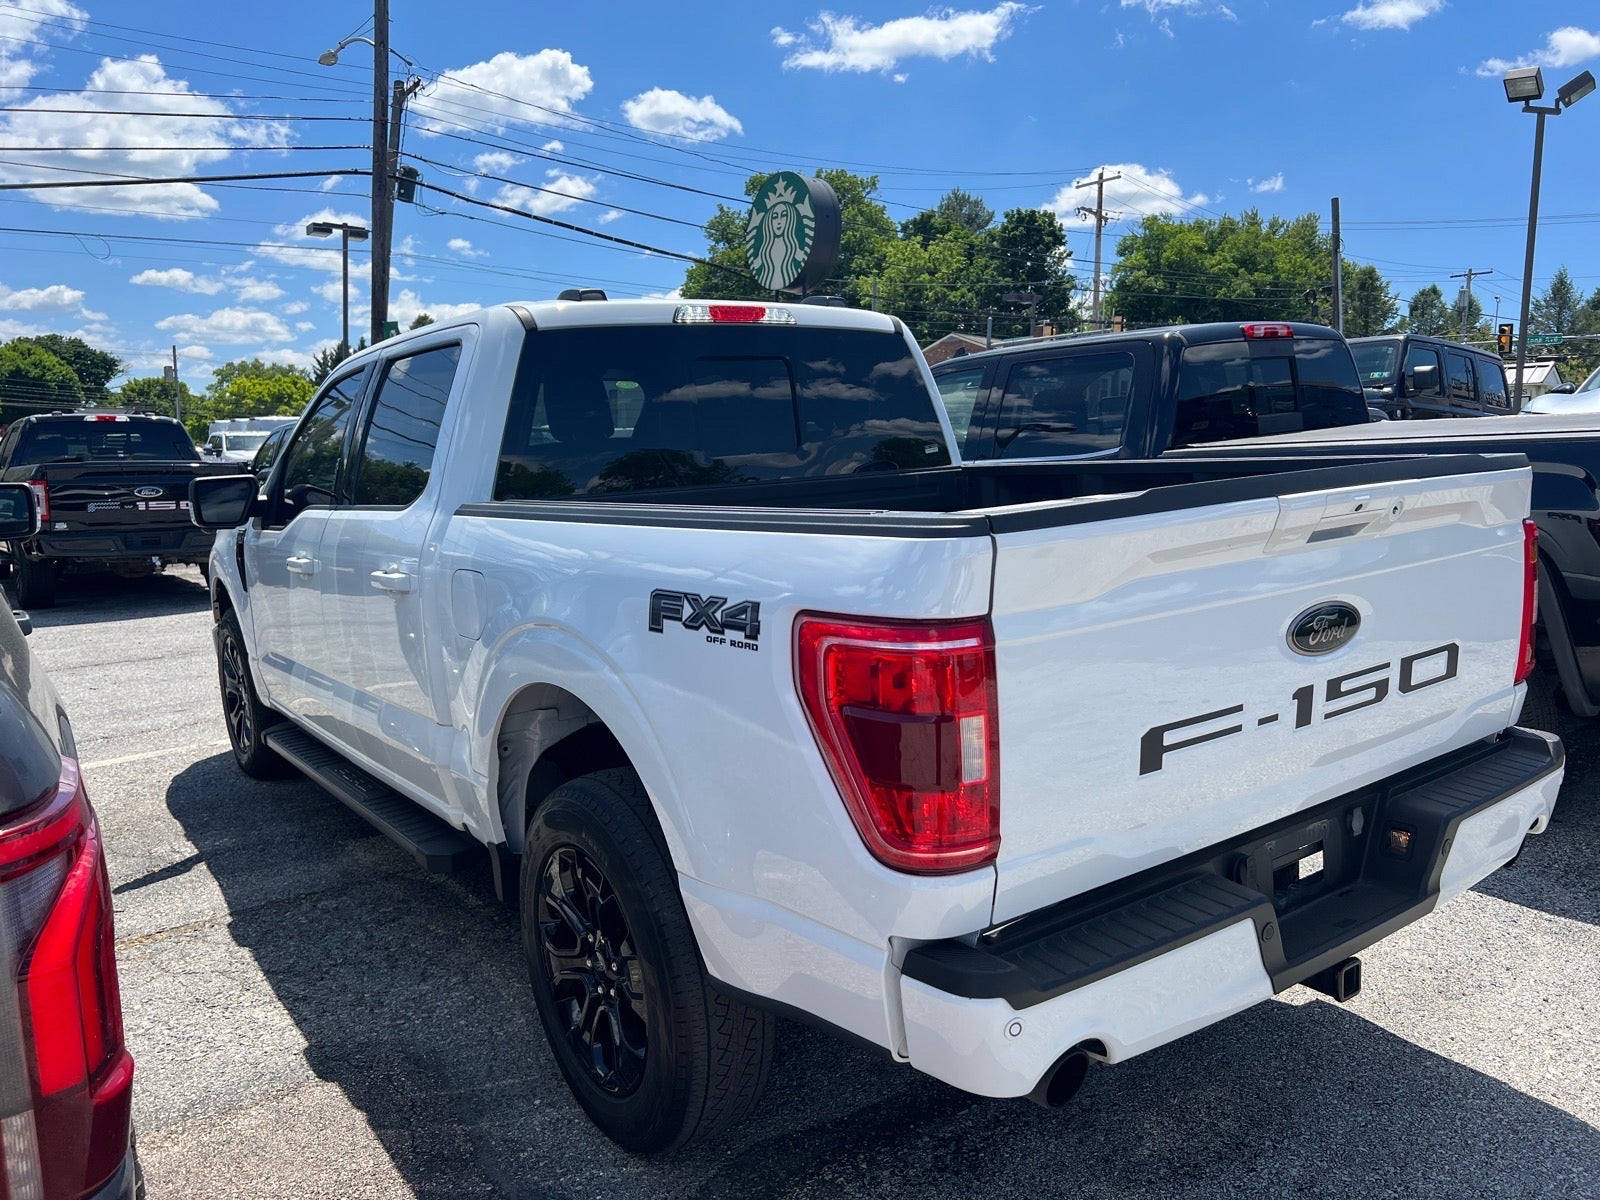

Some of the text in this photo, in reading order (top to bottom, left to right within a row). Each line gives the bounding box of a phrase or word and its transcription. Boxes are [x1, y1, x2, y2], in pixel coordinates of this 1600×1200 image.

[648, 588, 760, 641] FX4
[1306, 612, 1349, 646] Ford
[706, 635, 759, 652] OFF ROAD
[1139, 641, 1460, 776] F-150
